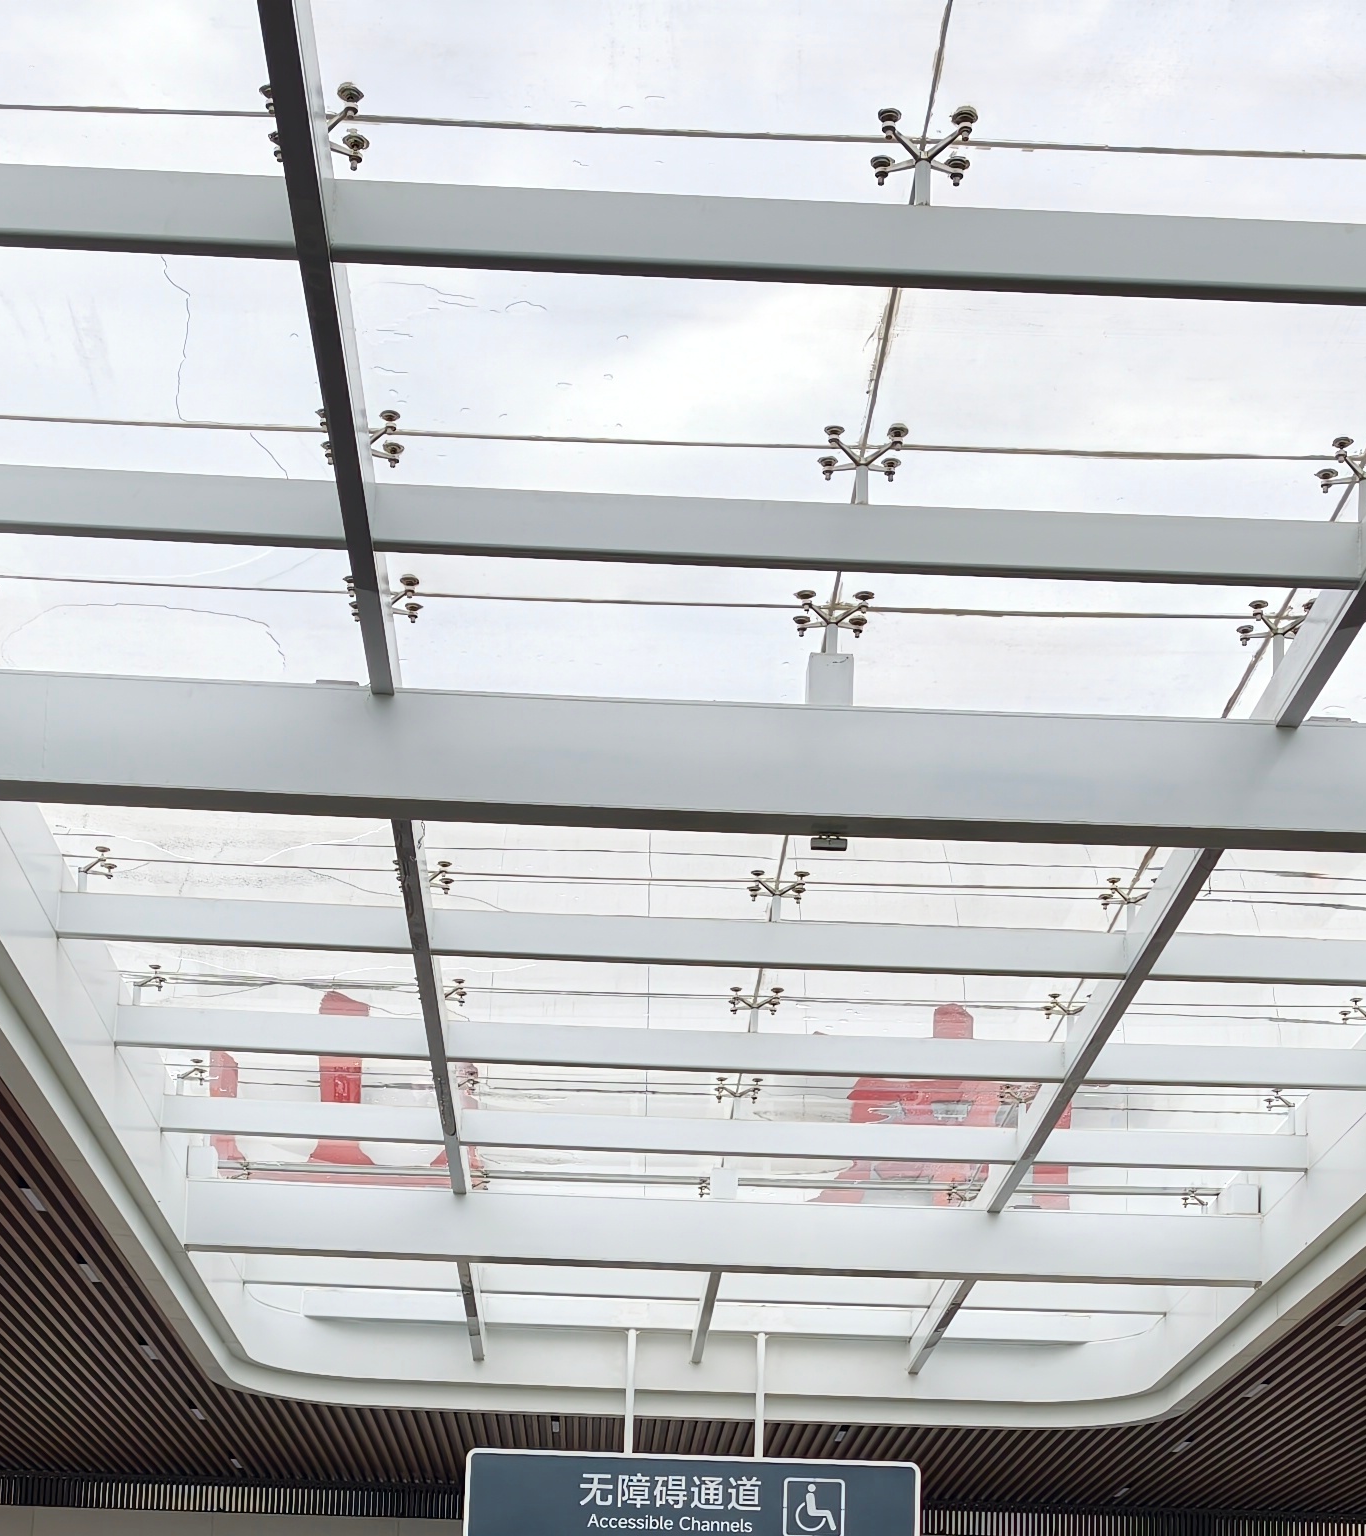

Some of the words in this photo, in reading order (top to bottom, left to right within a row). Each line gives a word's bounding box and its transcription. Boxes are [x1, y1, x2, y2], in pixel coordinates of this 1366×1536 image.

[579, 1473, 762, 1512] 无障碍通道
[586, 1513, 674, 1531] Accessible
[679, 1516, 753, 1533] Channels
